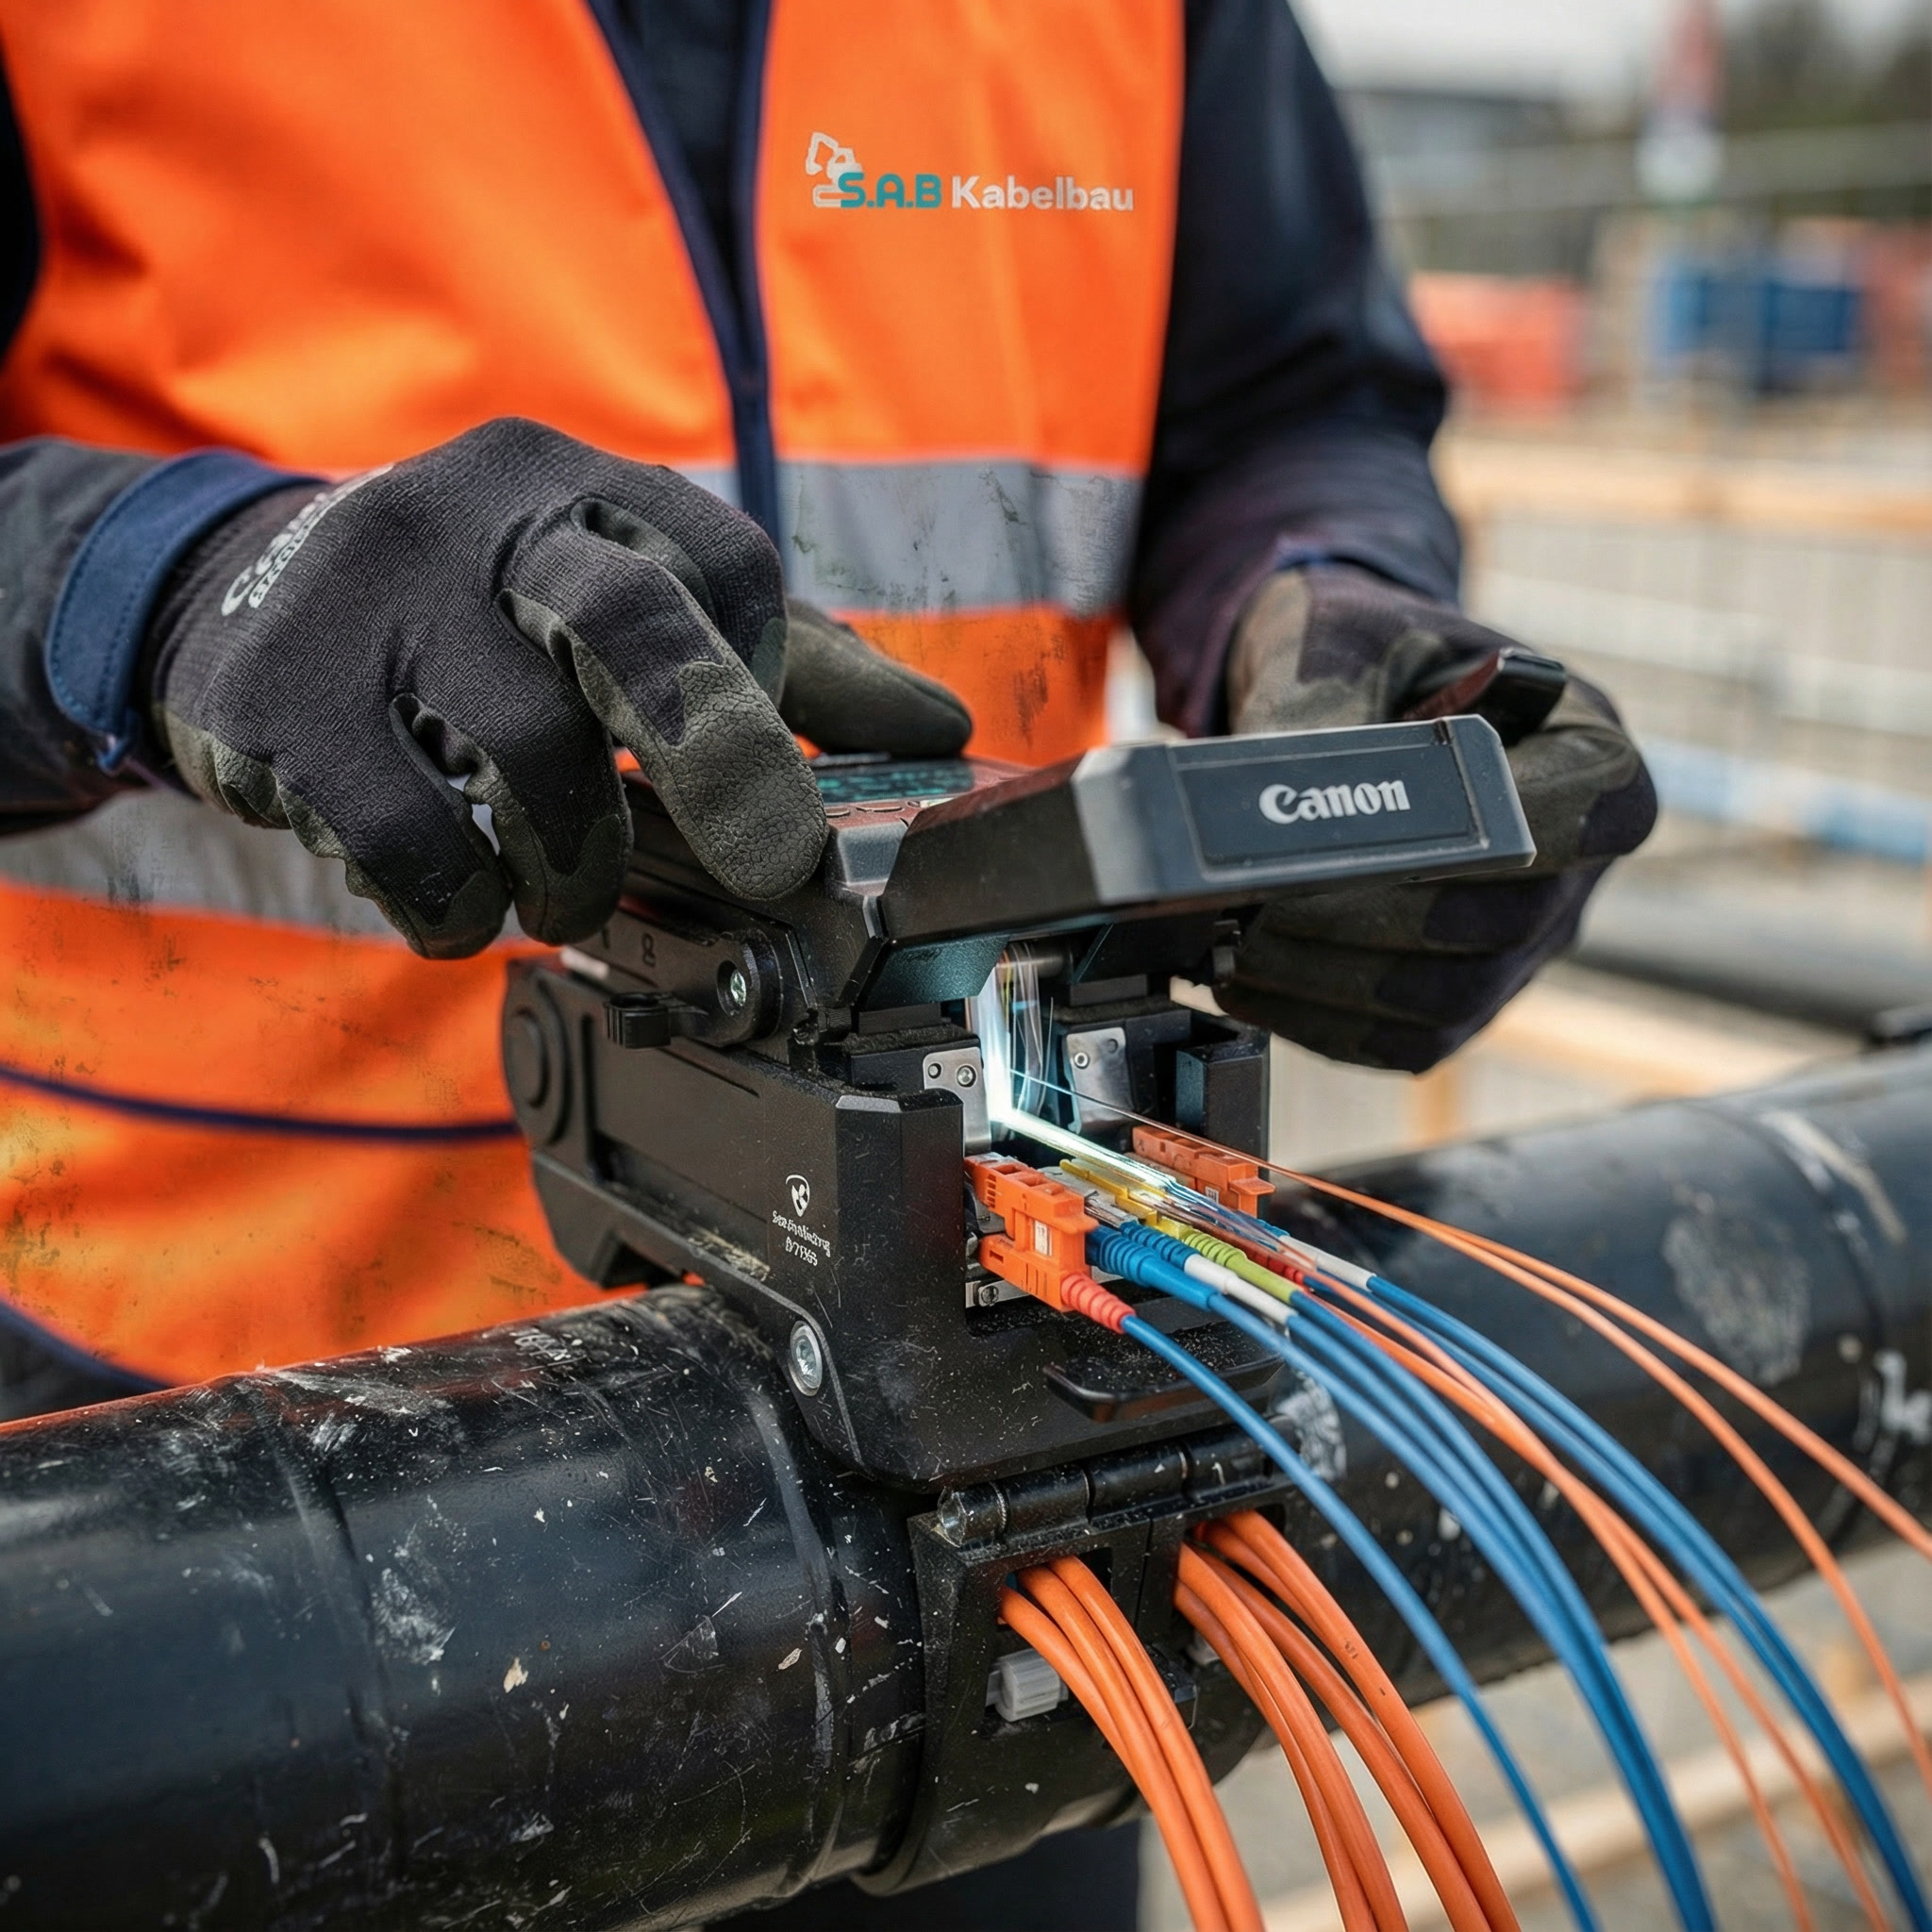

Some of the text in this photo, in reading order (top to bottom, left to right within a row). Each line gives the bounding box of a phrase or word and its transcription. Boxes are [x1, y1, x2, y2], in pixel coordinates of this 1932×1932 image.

[838, 173, 1134, 212] S.A.B Kabelbau
[1258, 779, 1411, 824] Canon
